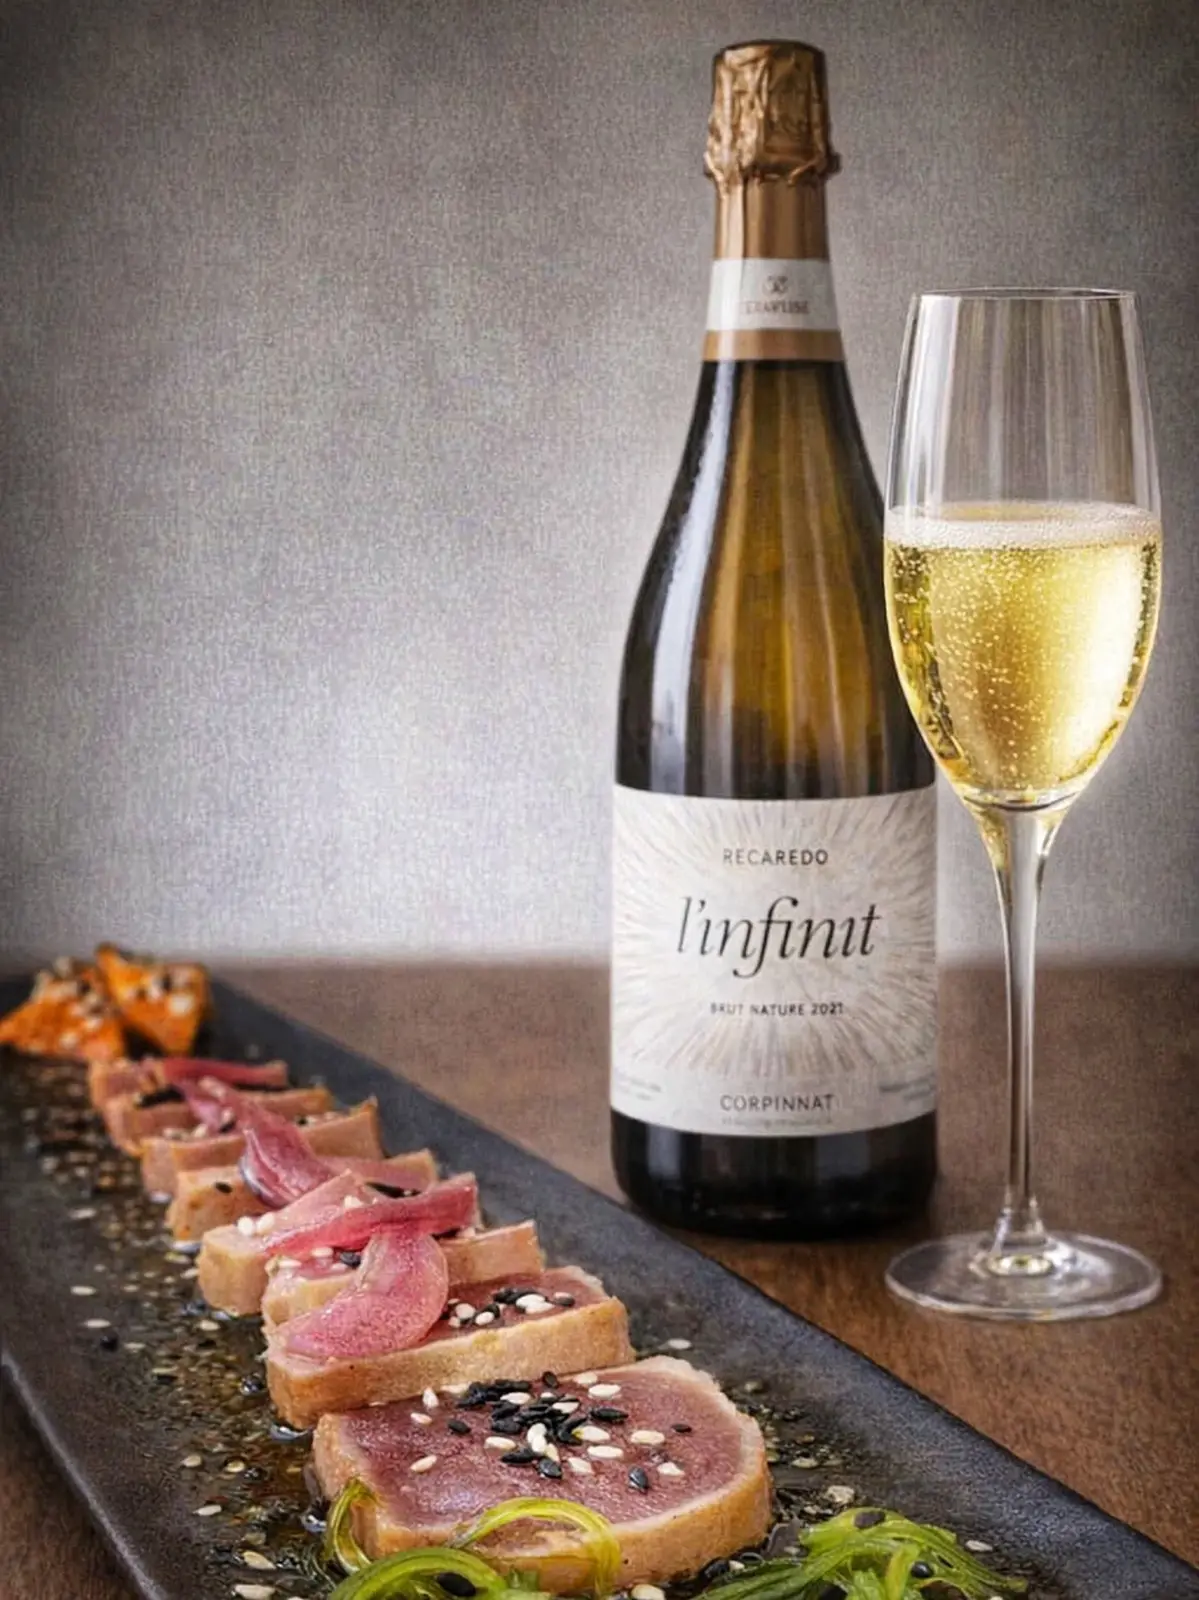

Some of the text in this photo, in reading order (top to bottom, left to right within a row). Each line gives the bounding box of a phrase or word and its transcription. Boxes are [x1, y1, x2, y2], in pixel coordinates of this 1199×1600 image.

[723, 848, 829, 866] RECAREDO
[709, 1001, 744, 1015] BRUT
[750, 1002, 805, 1017] NATURE
[719, 1093, 835, 1113] CORPINNAT
